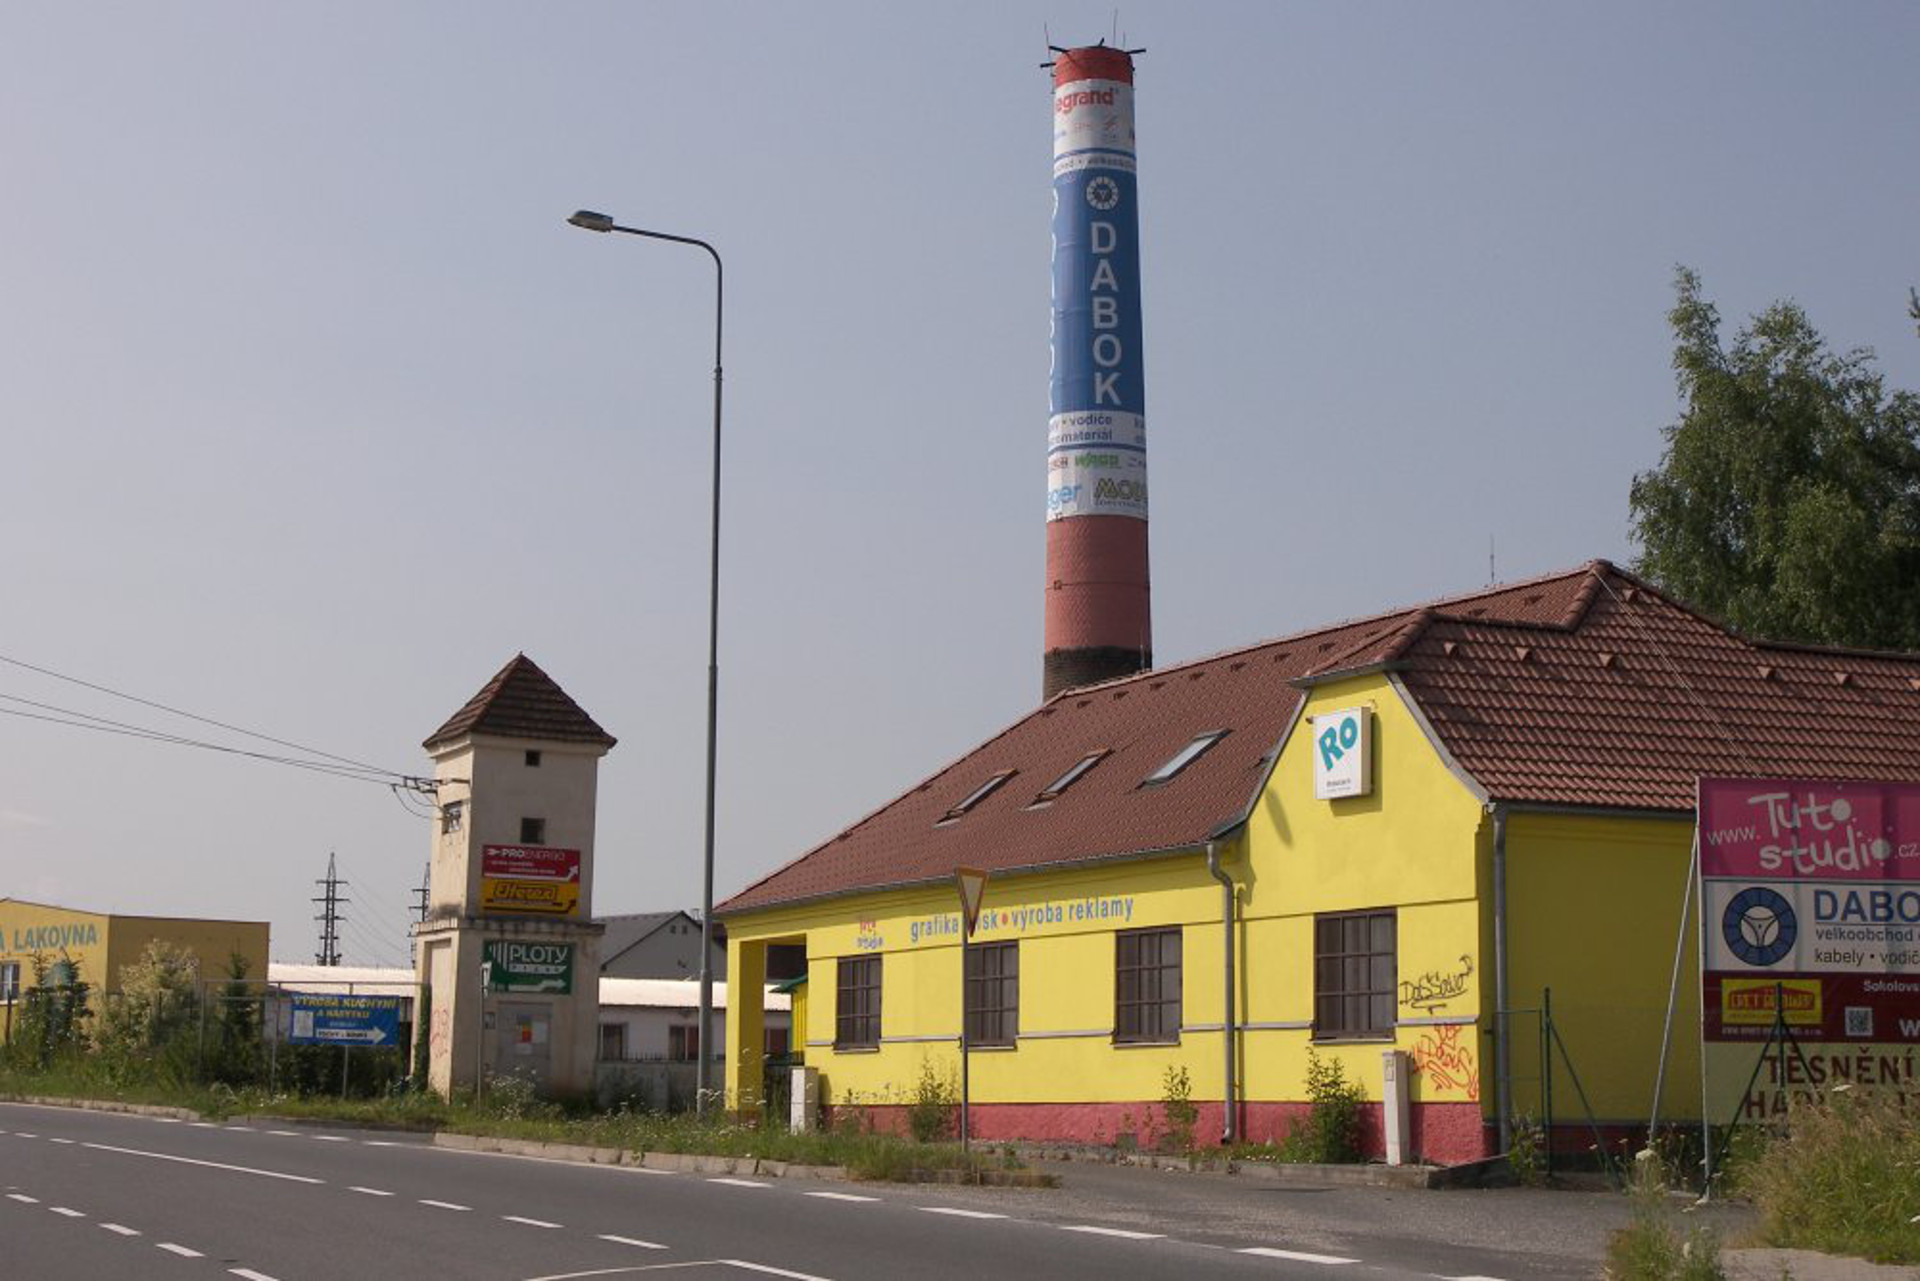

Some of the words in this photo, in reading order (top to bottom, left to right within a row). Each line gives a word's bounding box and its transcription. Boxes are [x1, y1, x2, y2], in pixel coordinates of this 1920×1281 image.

[1090, 220, 1122, 406] DABOK
[1318, 717, 1358, 772] RO
[1748, 792, 1851, 838] Tuto
[1759, 826, 1891, 875] studio
[14, 921, 97, 952] LAKOVNA
[910, 914, 959, 943] grafika
[1067, 895, 1134, 922] reklamy
[1815, 926, 1914, 942] velkoobchod
[509, 944, 568, 964] PLOTY
[1814, 947, 1865, 968] kabely
[1763, 1045, 1915, 1085] TĚSNĚNÍ
